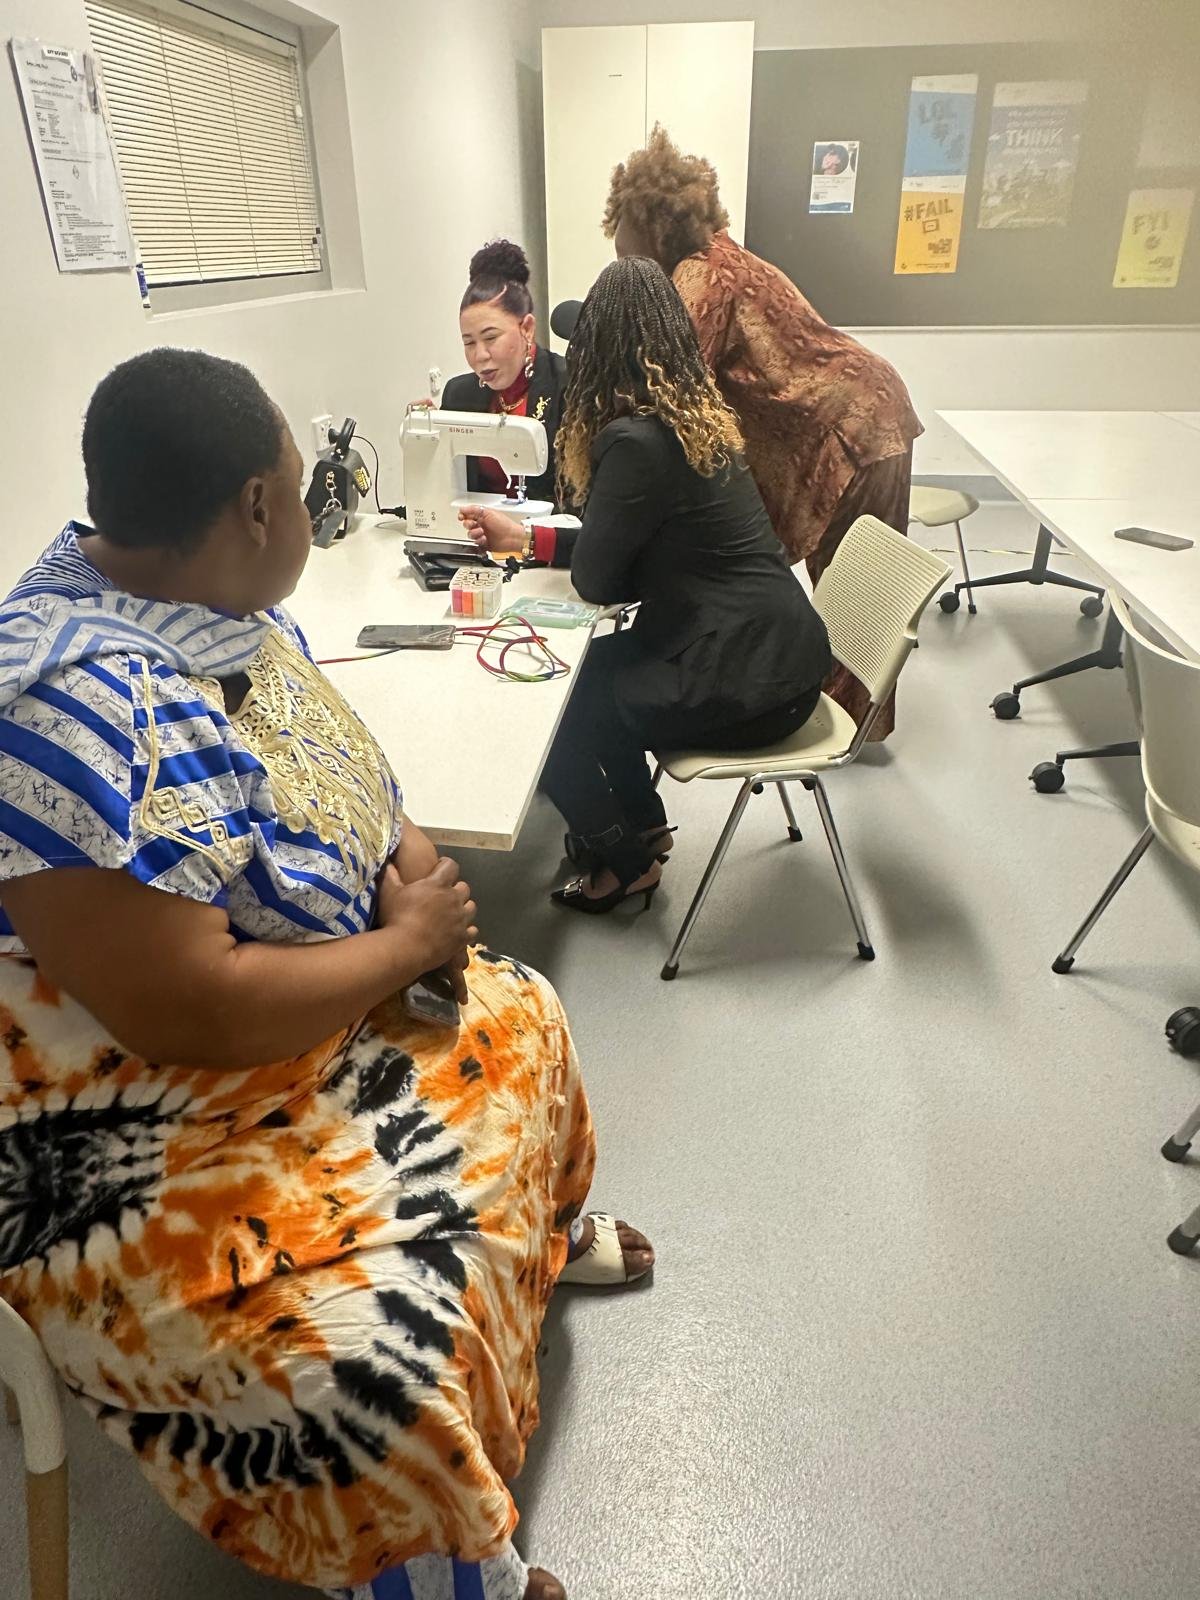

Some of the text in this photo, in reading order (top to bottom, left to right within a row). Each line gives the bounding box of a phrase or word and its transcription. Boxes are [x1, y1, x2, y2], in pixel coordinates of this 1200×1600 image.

[904, 199, 953, 222] #FAIL
[1132, 210, 1169, 235] FYI
[448, 426, 474, 434] SINGER
